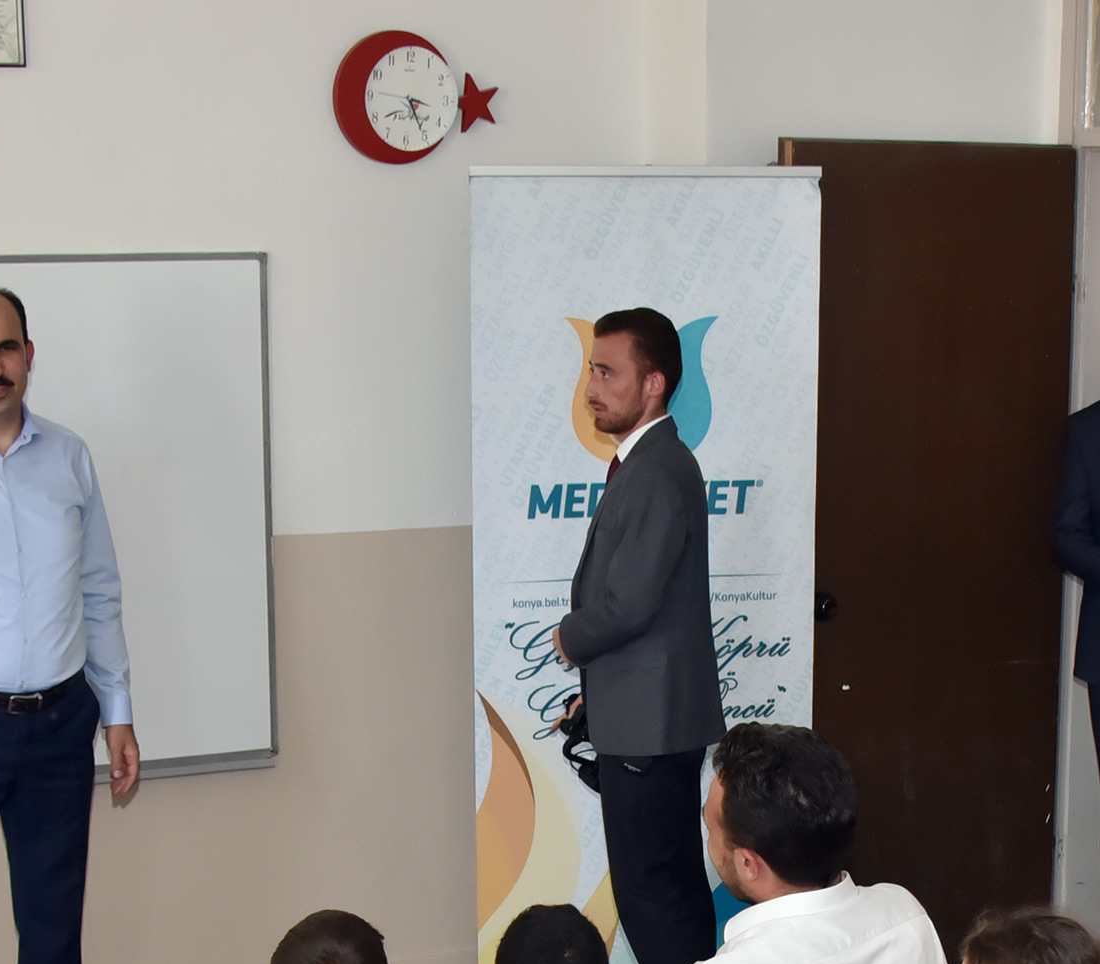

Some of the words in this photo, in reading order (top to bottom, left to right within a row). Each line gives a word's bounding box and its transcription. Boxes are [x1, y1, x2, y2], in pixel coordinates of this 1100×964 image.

[406, 50, 416, 63] 12
[427, 57, 432, 70] 1
[372, 68, 383, 81] 10
[437, 74, 445, 87] 2
[367, 89, 375, 102] 9
[442, 95, 450, 108] 3
[371, 111, 379, 124] 8
[435, 116, 443, 128] 4
[385, 127, 392, 140] 7
[421, 129, 429, 143] 5
[402, 134, 410, 147] 6
[751, 217, 784, 273] AKILLI
[512, 597, 570, 610] konya.bel.tr
